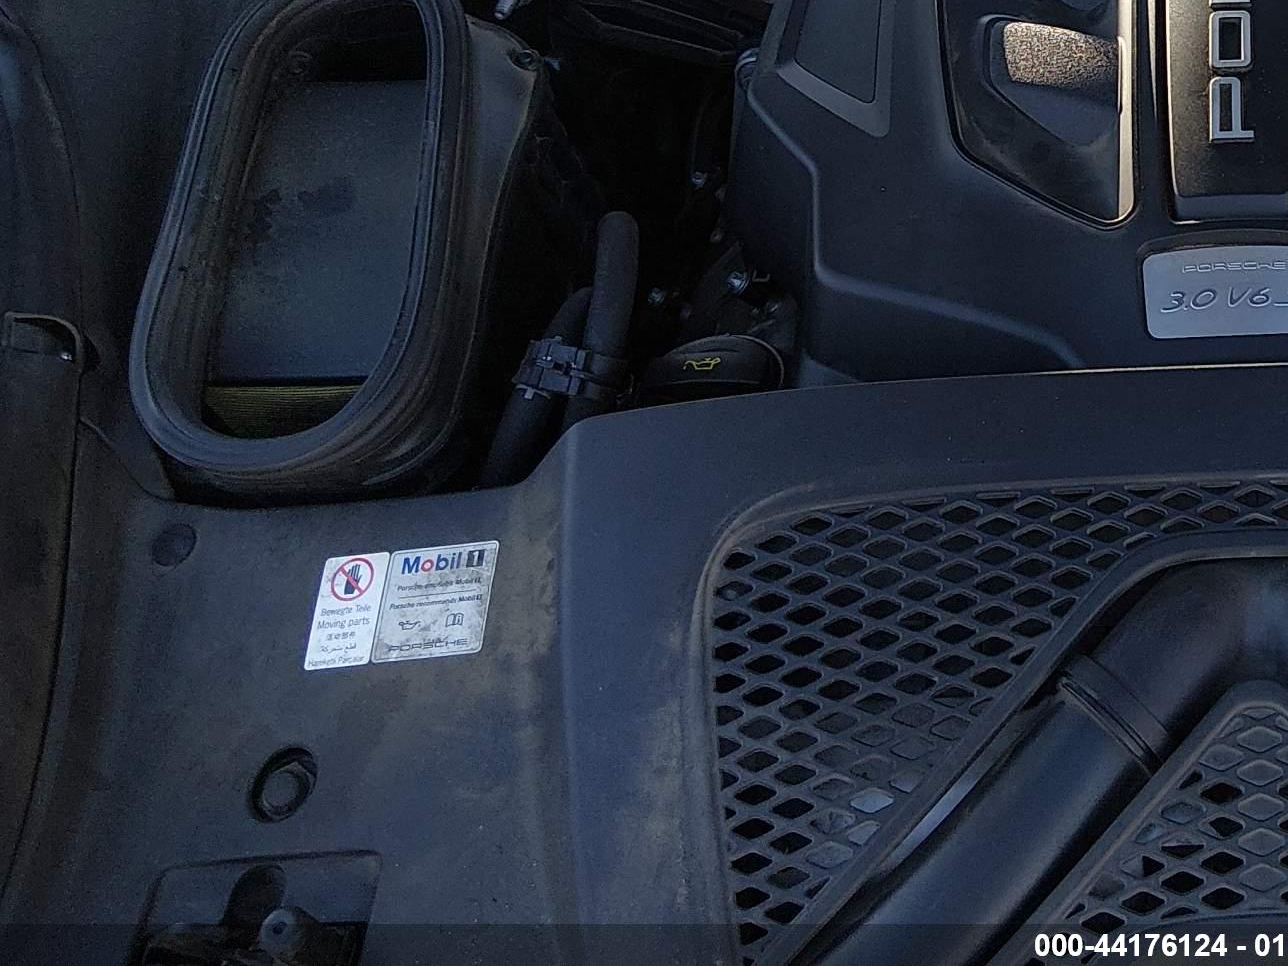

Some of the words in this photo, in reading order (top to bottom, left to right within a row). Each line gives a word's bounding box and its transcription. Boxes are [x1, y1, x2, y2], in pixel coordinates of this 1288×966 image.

[1182, 260, 1287, 274] PORSCHE
[1160, 288, 1217, 313] 3.0
[1227, 287, 1270, 308] V6
[401, 552, 462, 574] Mobil
[397, 582, 422, 592] Porsche
[320, 607, 353, 617] Bewegte
[389, 602, 415, 611] Porsche
[317, 618, 347, 629] Moving
[347, 617, 371, 627] parts
[388, 638, 468, 652] PORSCHE
